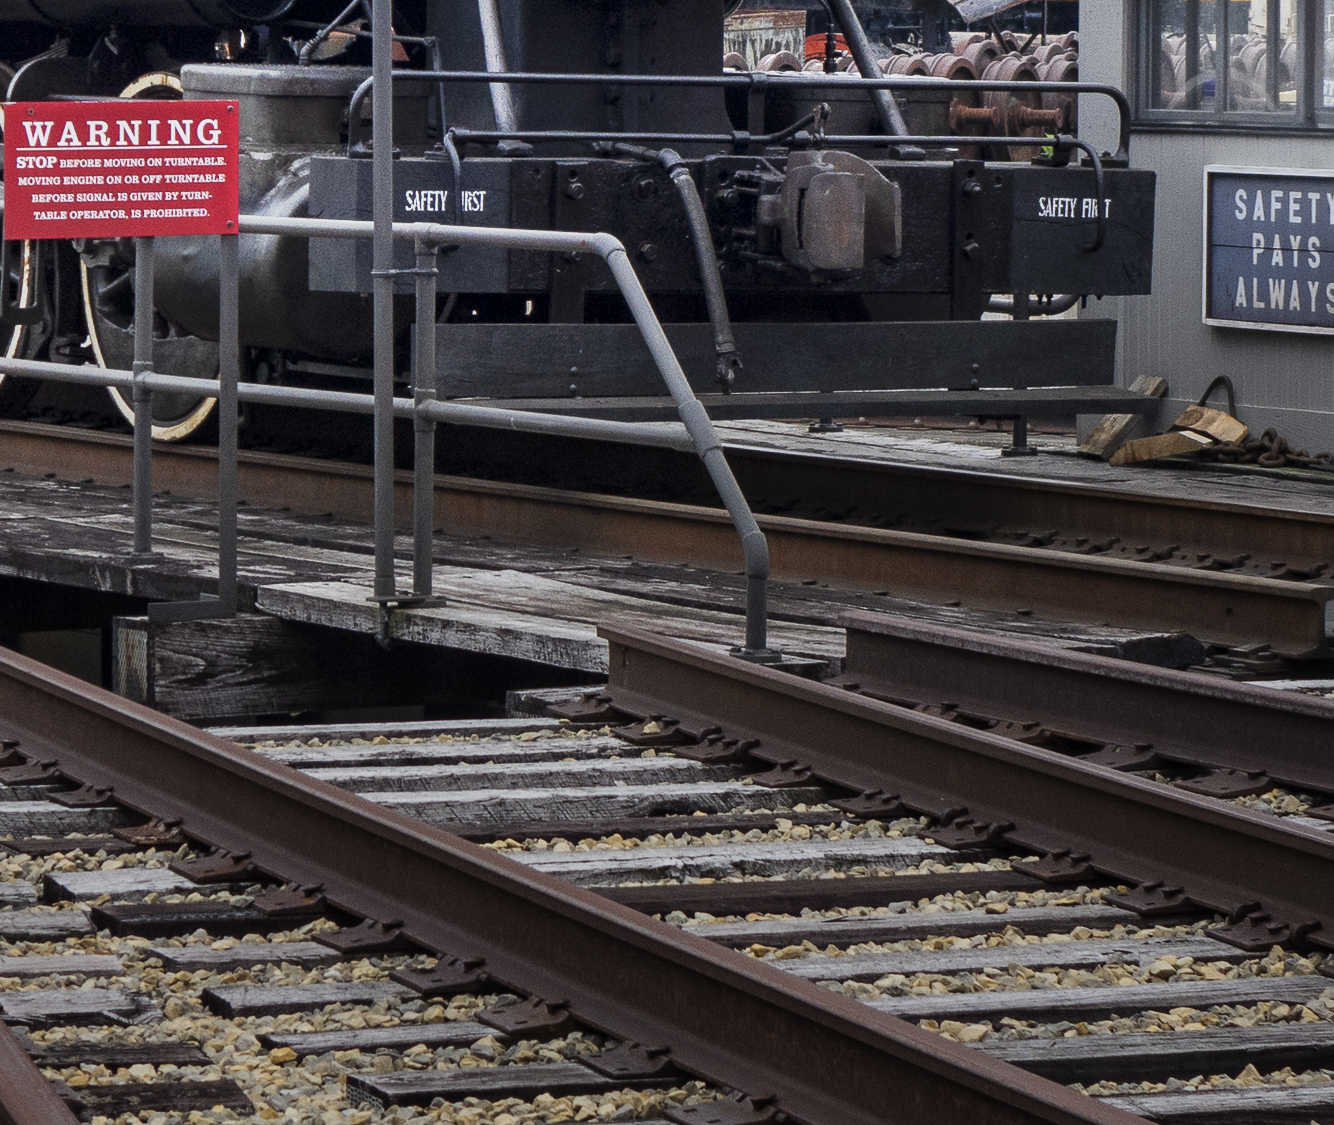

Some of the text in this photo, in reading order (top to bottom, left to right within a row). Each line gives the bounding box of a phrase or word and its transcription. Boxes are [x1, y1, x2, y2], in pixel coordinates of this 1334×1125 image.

[22, 118, 222, 147] WARNING
[16, 155, 227, 169] STOP BEFORE MOVING ON TURNTABLE.
[17, 174, 226, 186] MOVING ENGINE ON OR OFF TURNTABLE
[31, 191, 212, 203] BEFORE SIGNAL IS GIVEN BY TURN-
[405, 190, 486, 212] SAFETY IRST
[33, 208, 210, 220] TABLE OPERATOR, IS PROHIBITED.
[1038, 196, 1112, 219] SAFETY FIRT
[1252, 232, 1321, 269] PAYS
